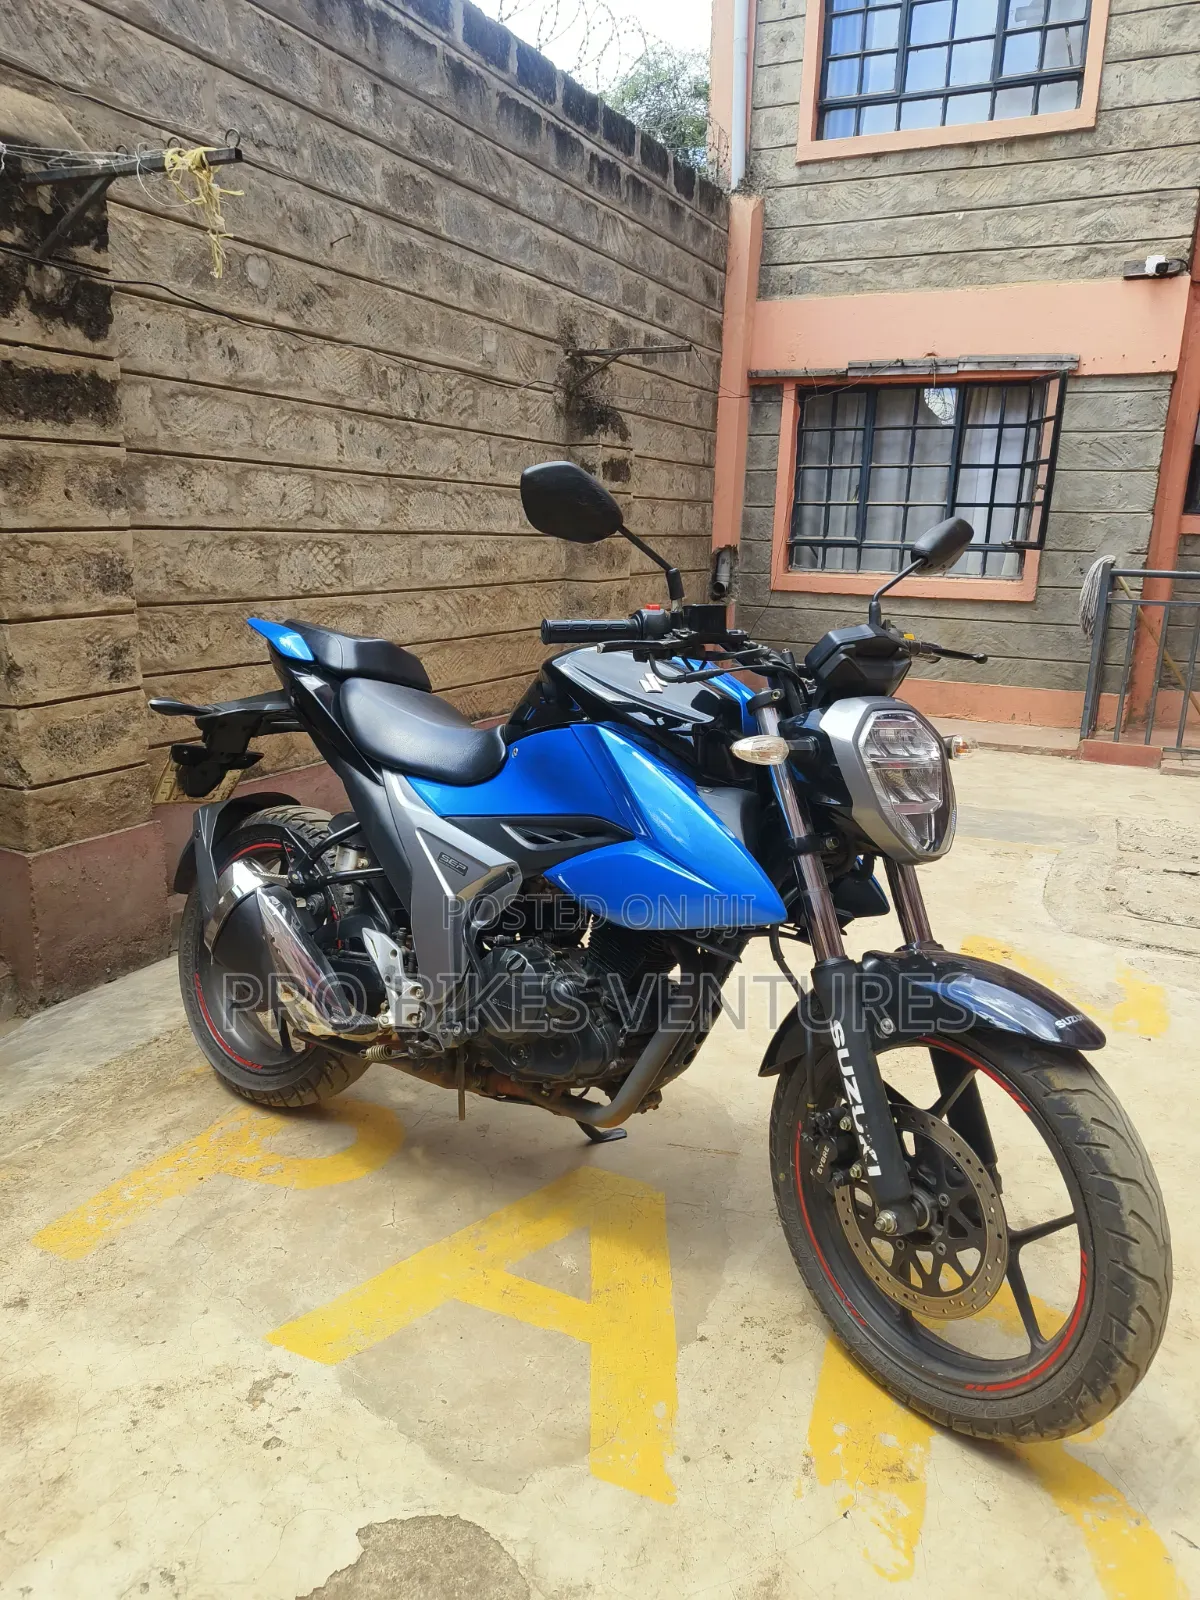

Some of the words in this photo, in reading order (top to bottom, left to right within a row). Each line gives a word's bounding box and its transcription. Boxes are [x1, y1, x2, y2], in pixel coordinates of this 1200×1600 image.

[440, 854, 467, 870] SEP
[1054, 1013, 1086, 1029] SUZU
[829, 1019, 882, 1177] SUZUKI
[816, 1145, 830, 1175] BYBRE
